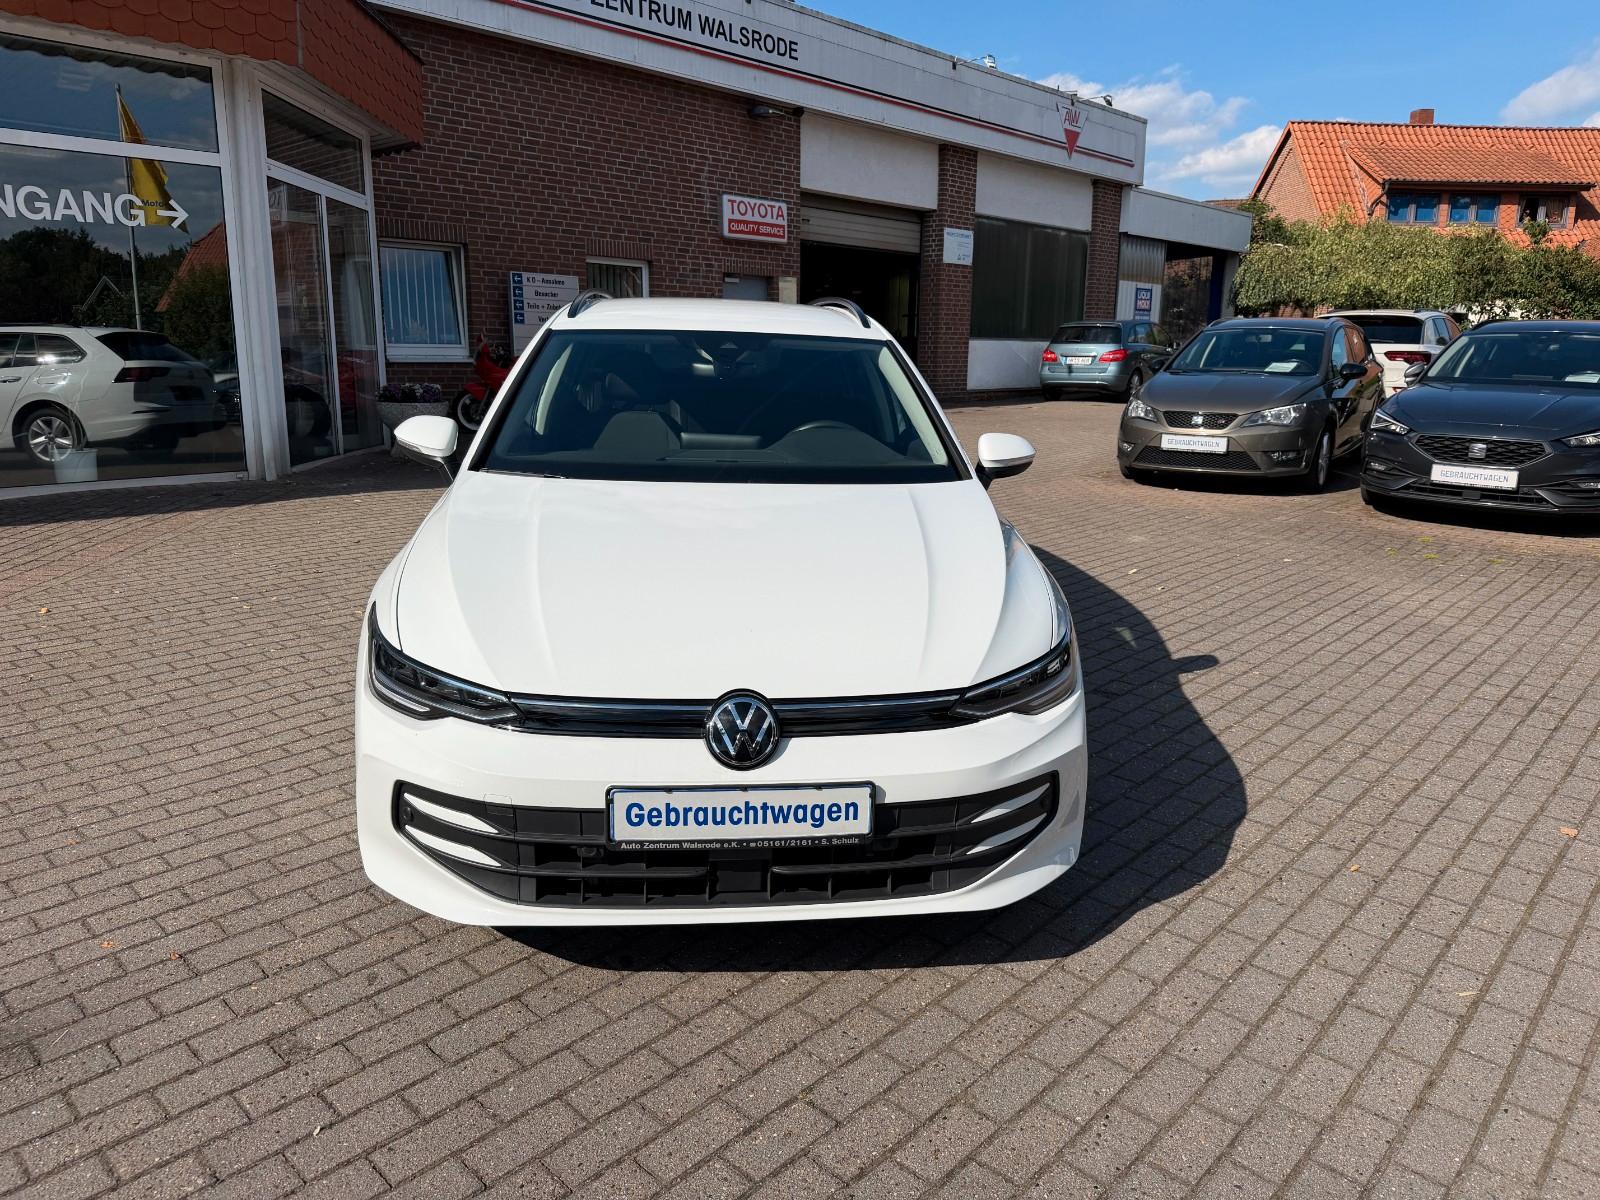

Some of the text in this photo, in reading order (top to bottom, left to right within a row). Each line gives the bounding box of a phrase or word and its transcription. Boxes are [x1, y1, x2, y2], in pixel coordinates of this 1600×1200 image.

[590, 0, 798, 61] ENTRUM WALSRODE
[728, 199, 785, 221] TOYOTA
[730, 222, 784, 236] QUALITY SERVICE
[1167, 438, 1220, 448] GEBRAUCHTWAGEN
[1440, 470, 1509, 483] GEBRAUCHTWAGEN
[625, 801, 859, 828] Gebrauchtwagen
[682, 841, 721, 849] Walsrode
[832, 836, 860, 845] Schulz
